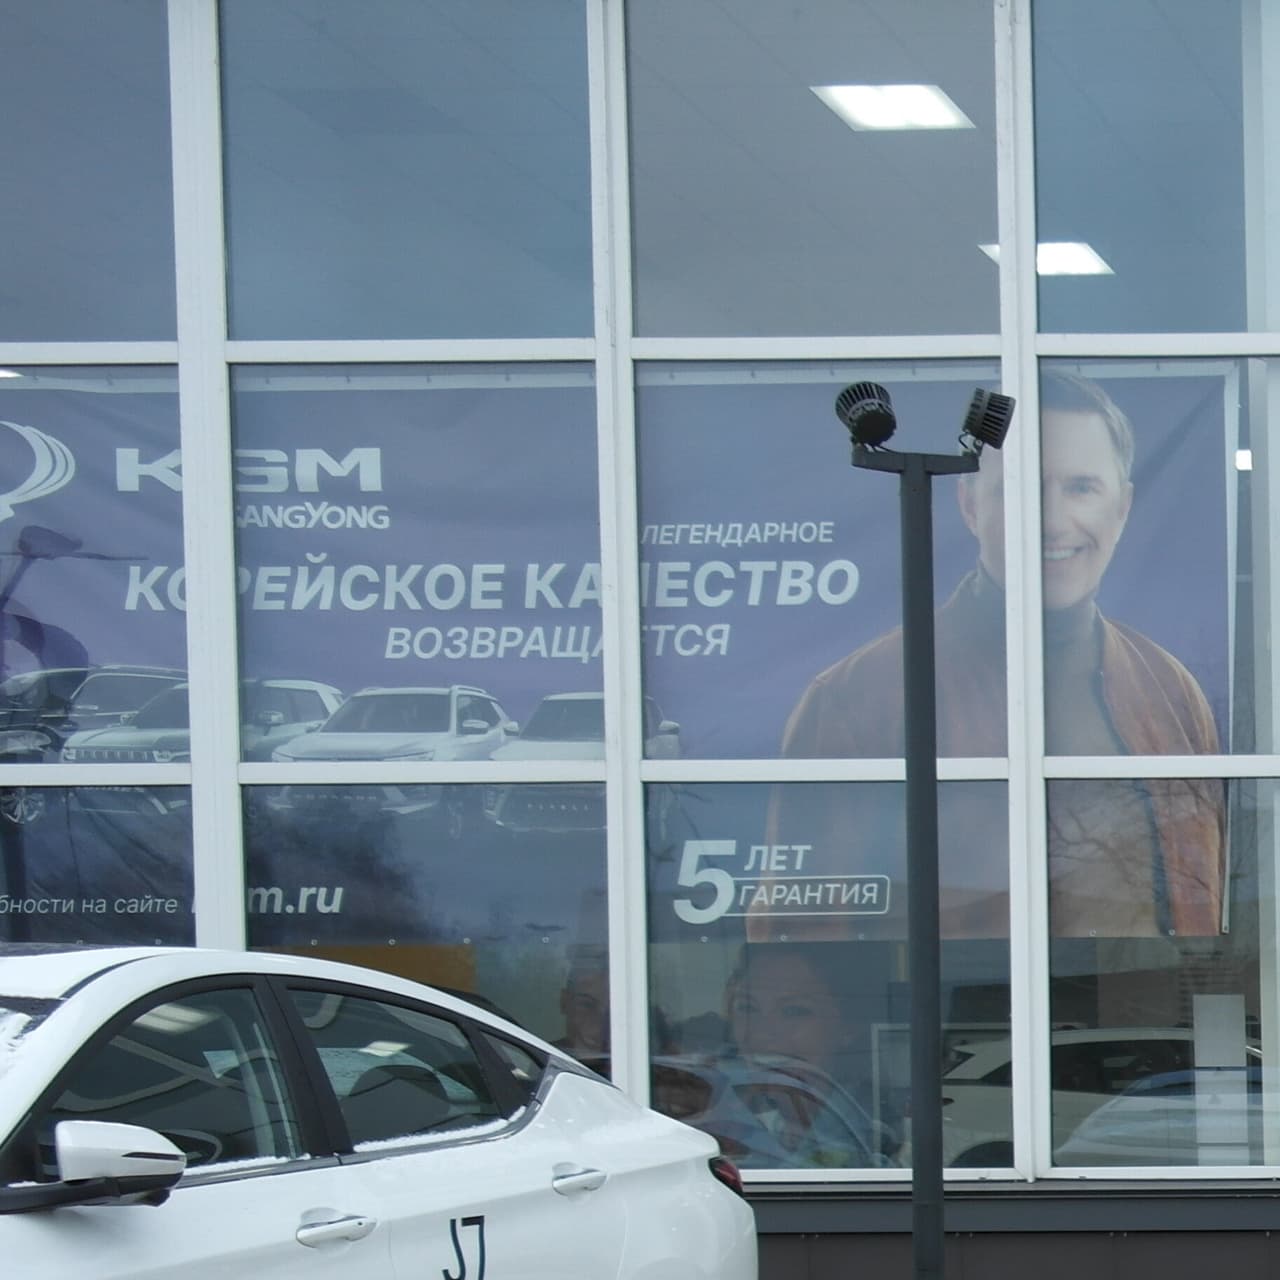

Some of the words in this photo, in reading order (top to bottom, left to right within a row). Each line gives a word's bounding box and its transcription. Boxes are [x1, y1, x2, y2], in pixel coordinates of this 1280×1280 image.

[640, 521, 835, 548] ЛЕГЕНДАРНОЕ
[384, 623, 731, 664] ВОЗВРАЩТСЯ
[673, 839, 736, 925] 5
[743, 844, 812, 872] ЛЕТ
[738, 882, 879, 907] ГАРАНТИЯ
[81, 897, 107, 914] на
[113, 894, 178, 914] сайте
